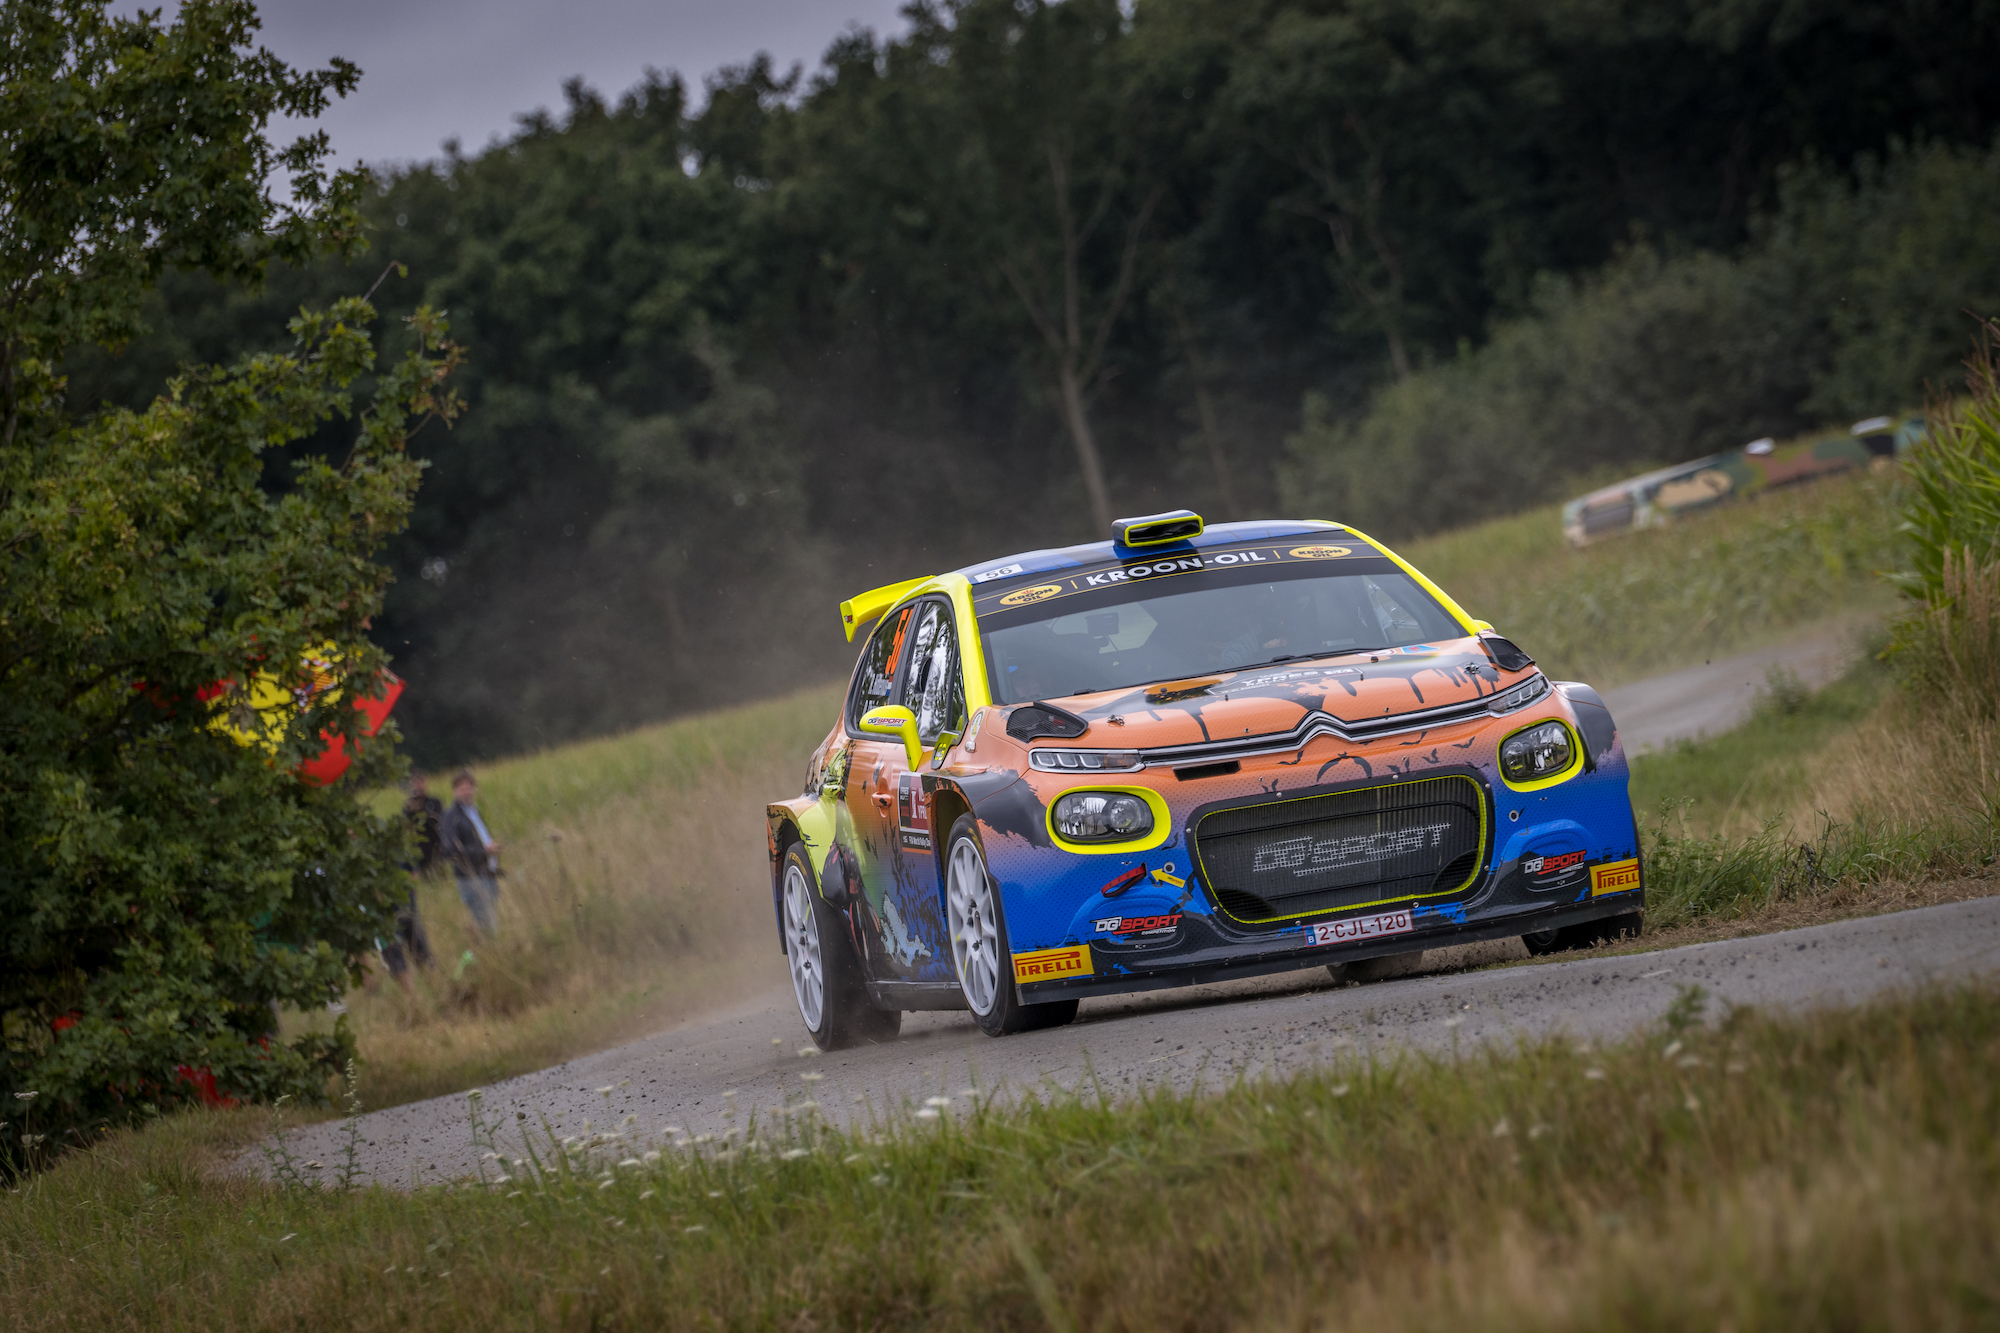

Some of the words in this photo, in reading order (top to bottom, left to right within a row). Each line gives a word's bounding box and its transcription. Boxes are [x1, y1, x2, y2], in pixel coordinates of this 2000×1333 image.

[1291, 548, 1343, 557] KROON
[1312, 551, 1334, 559] OIL
[986, 566, 1012, 579] 56
[1086, 550, 1266, 586] KROON-OIL
[1007, 587, 1053, 603] KROON
[1022, 594, 1043, 604] OIL
[1311, 822, 1451, 864] SPORT
[1524, 859, 1542, 875] DG
[1543, 850, 1587, 870] SPORT
[1095, 918, 1119, 932] DG
[1120, 914, 1183, 930] SPORT
[1318, 913, 1407, 941] 2-CJL-120
[1308, 935, 1315, 944] B
[1015, 951, 1082, 977] PIRELLI
